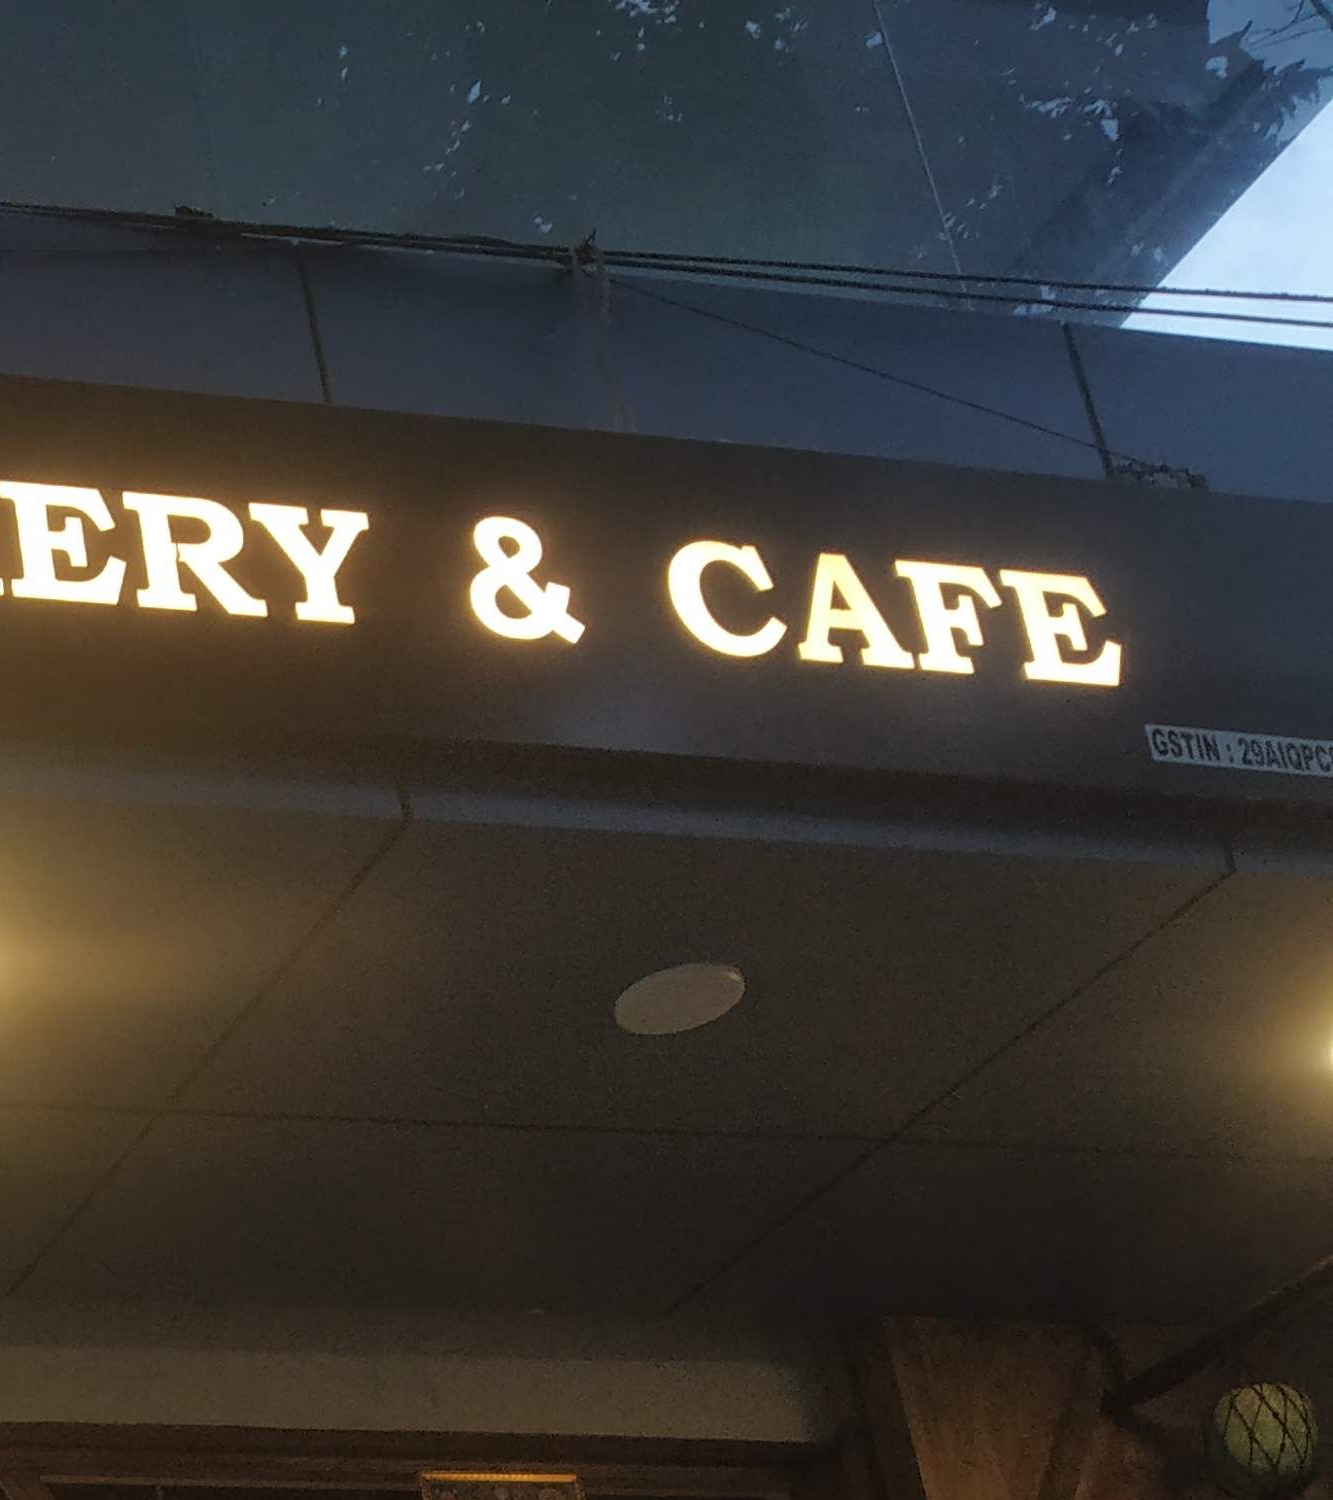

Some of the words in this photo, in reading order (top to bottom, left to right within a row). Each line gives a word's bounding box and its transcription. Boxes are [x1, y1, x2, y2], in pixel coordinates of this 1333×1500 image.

[469, 515, 585, 645] &
[667, 539, 1122, 687] CAFE
[1151, 728, 1222, 761] GSTIN
[1237, 737, 1333, 773] 29AIQPC
